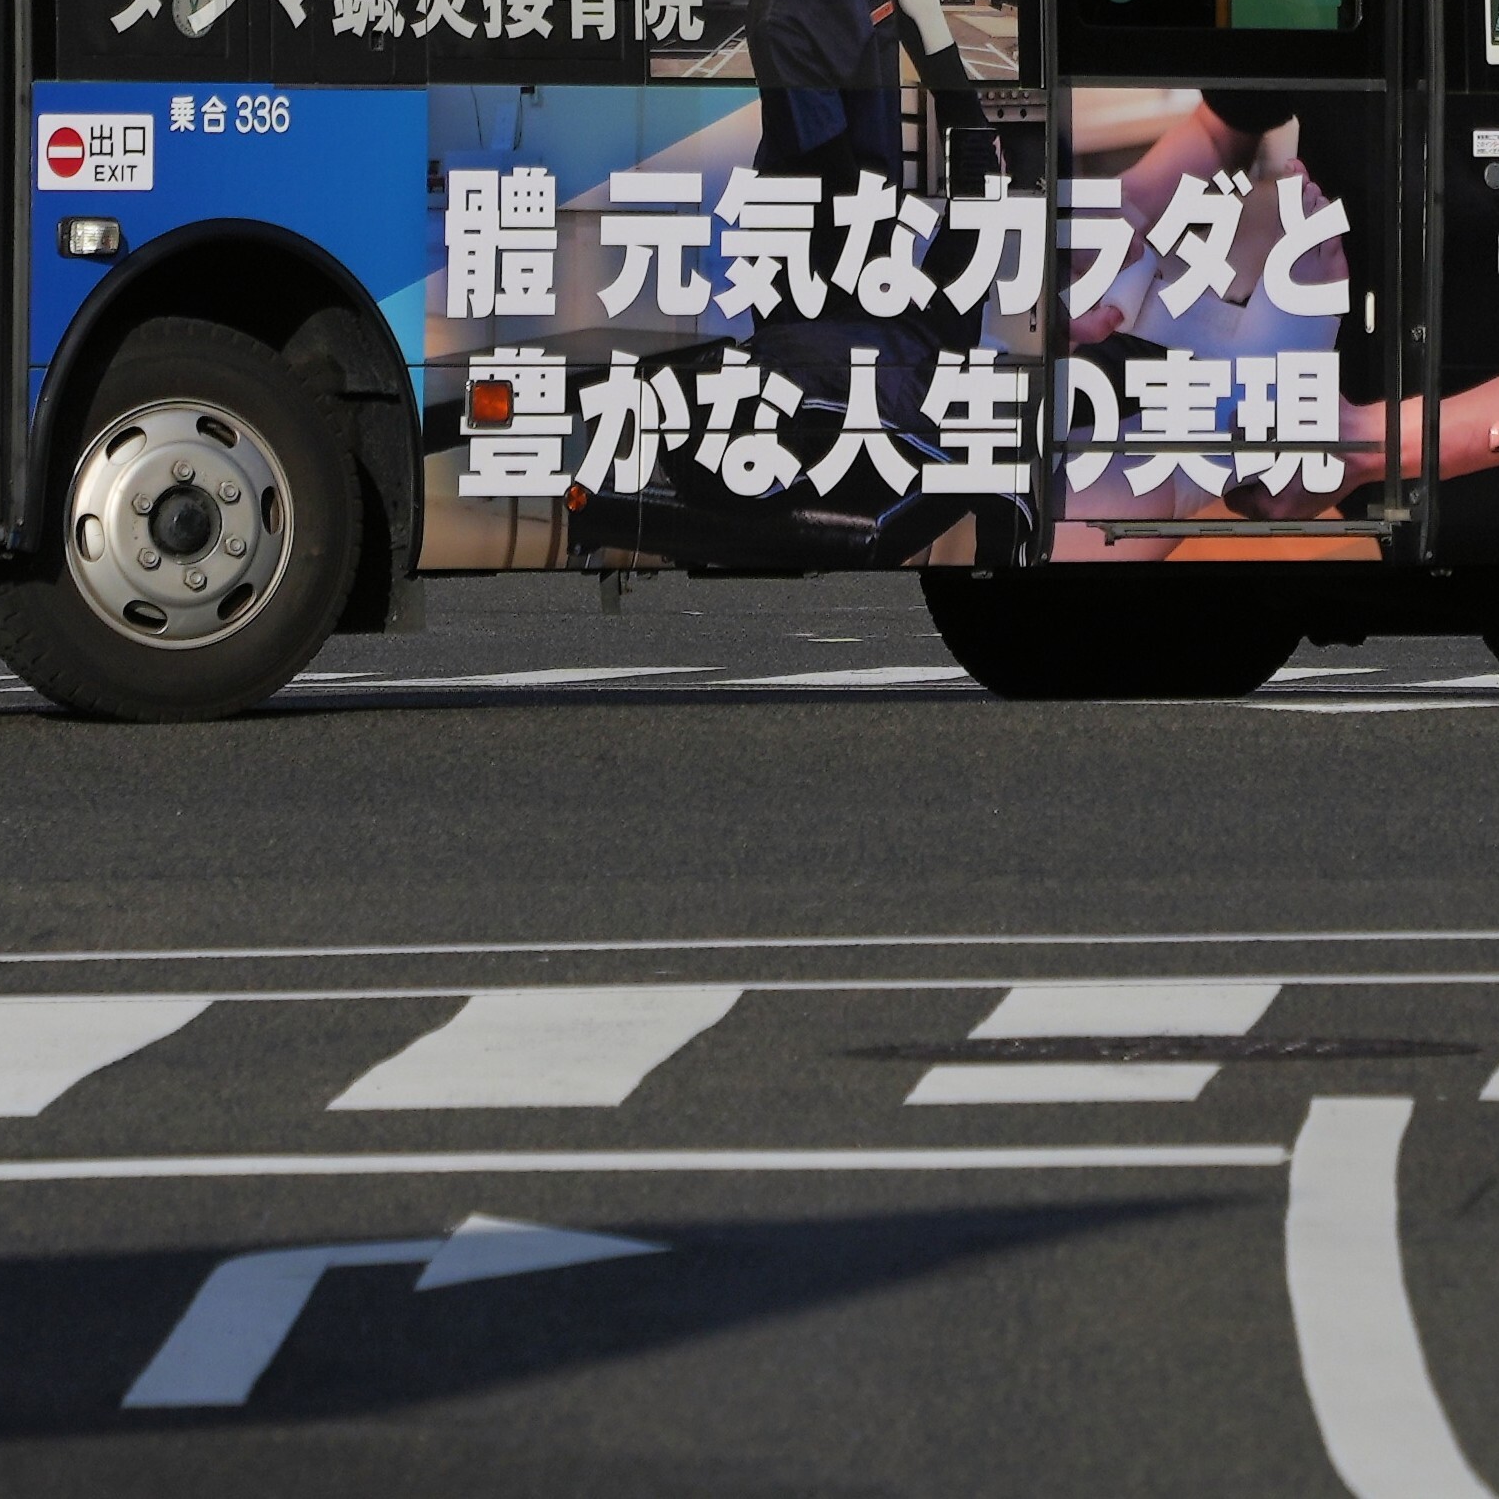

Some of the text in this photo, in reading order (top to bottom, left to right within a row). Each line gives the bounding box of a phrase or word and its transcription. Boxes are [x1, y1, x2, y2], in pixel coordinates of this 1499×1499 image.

[170, 96, 290, 134] 乗合 336
[88, 124, 146, 158] 出口
[94, 165, 137, 183] EXIT
[597, 167, 1352, 321] 元気なカラダと
[457, 347, 1346, 498] 豊かな人生の実現
